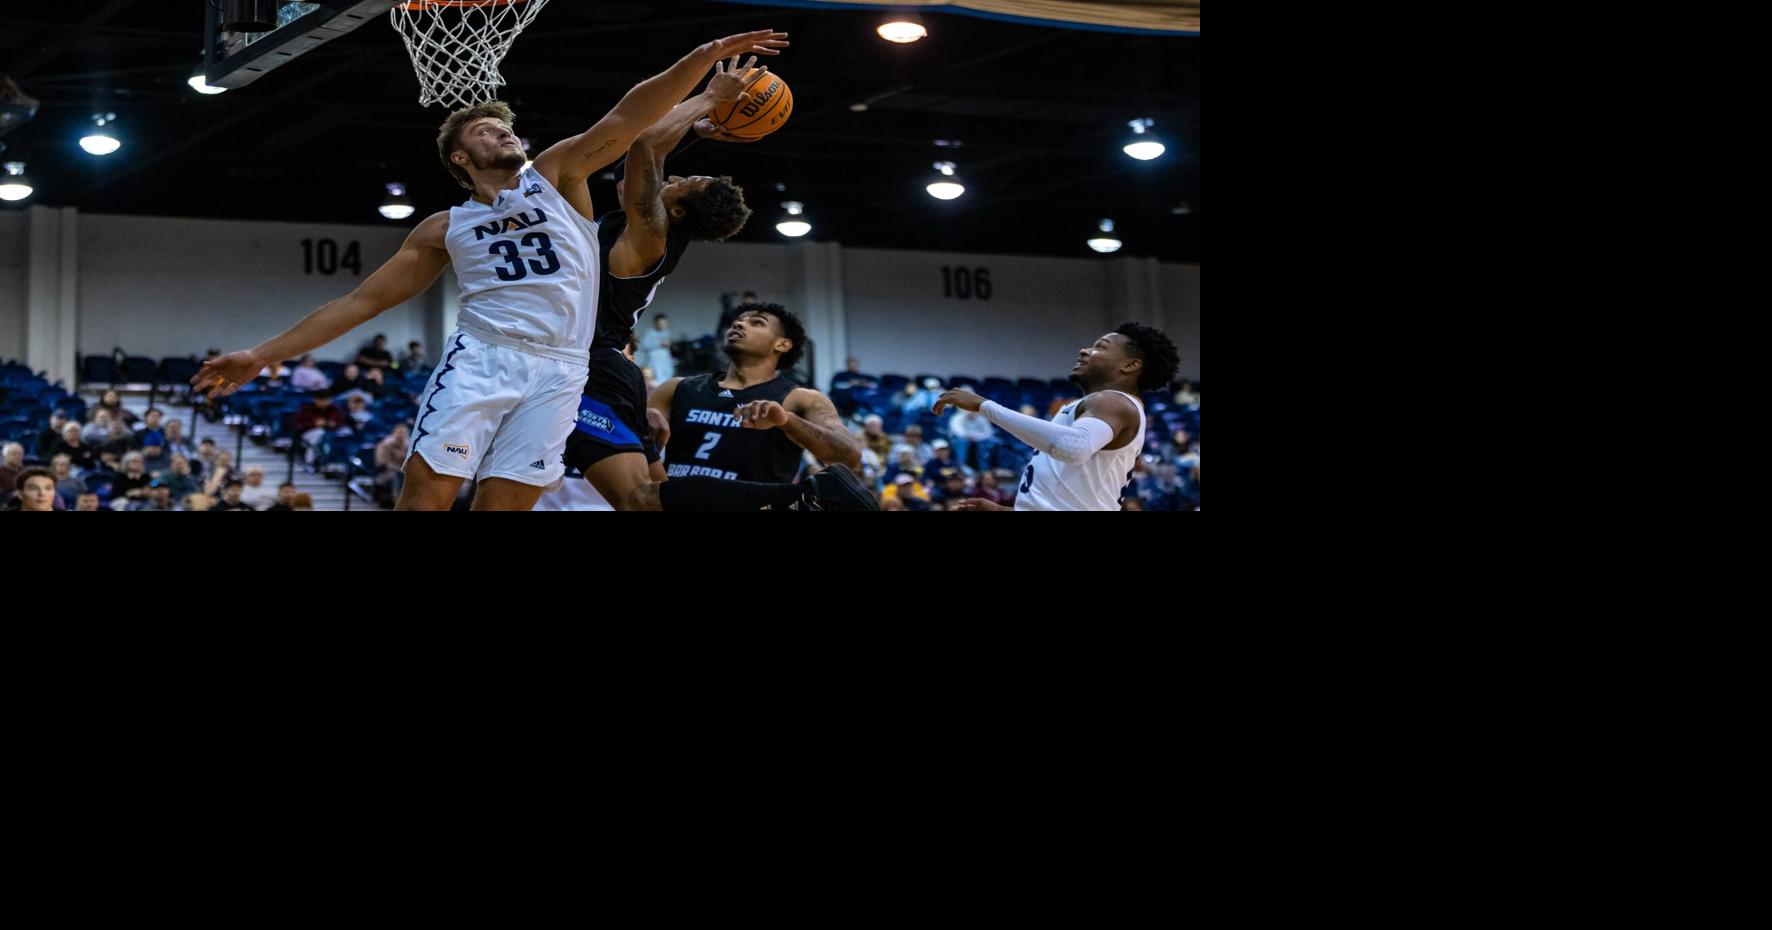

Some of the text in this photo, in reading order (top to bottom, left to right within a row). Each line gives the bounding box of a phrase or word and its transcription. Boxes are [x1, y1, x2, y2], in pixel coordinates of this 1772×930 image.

[739, 82, 779, 117] Wilson
[472, 208, 548, 240] NAU
[300, 238, 361, 275] 104
[488, 231, 561, 281] 33
[941, 266, 993, 300] 106
[446, 446, 468, 455] NAU
[694, 431, 722, 460] 2
